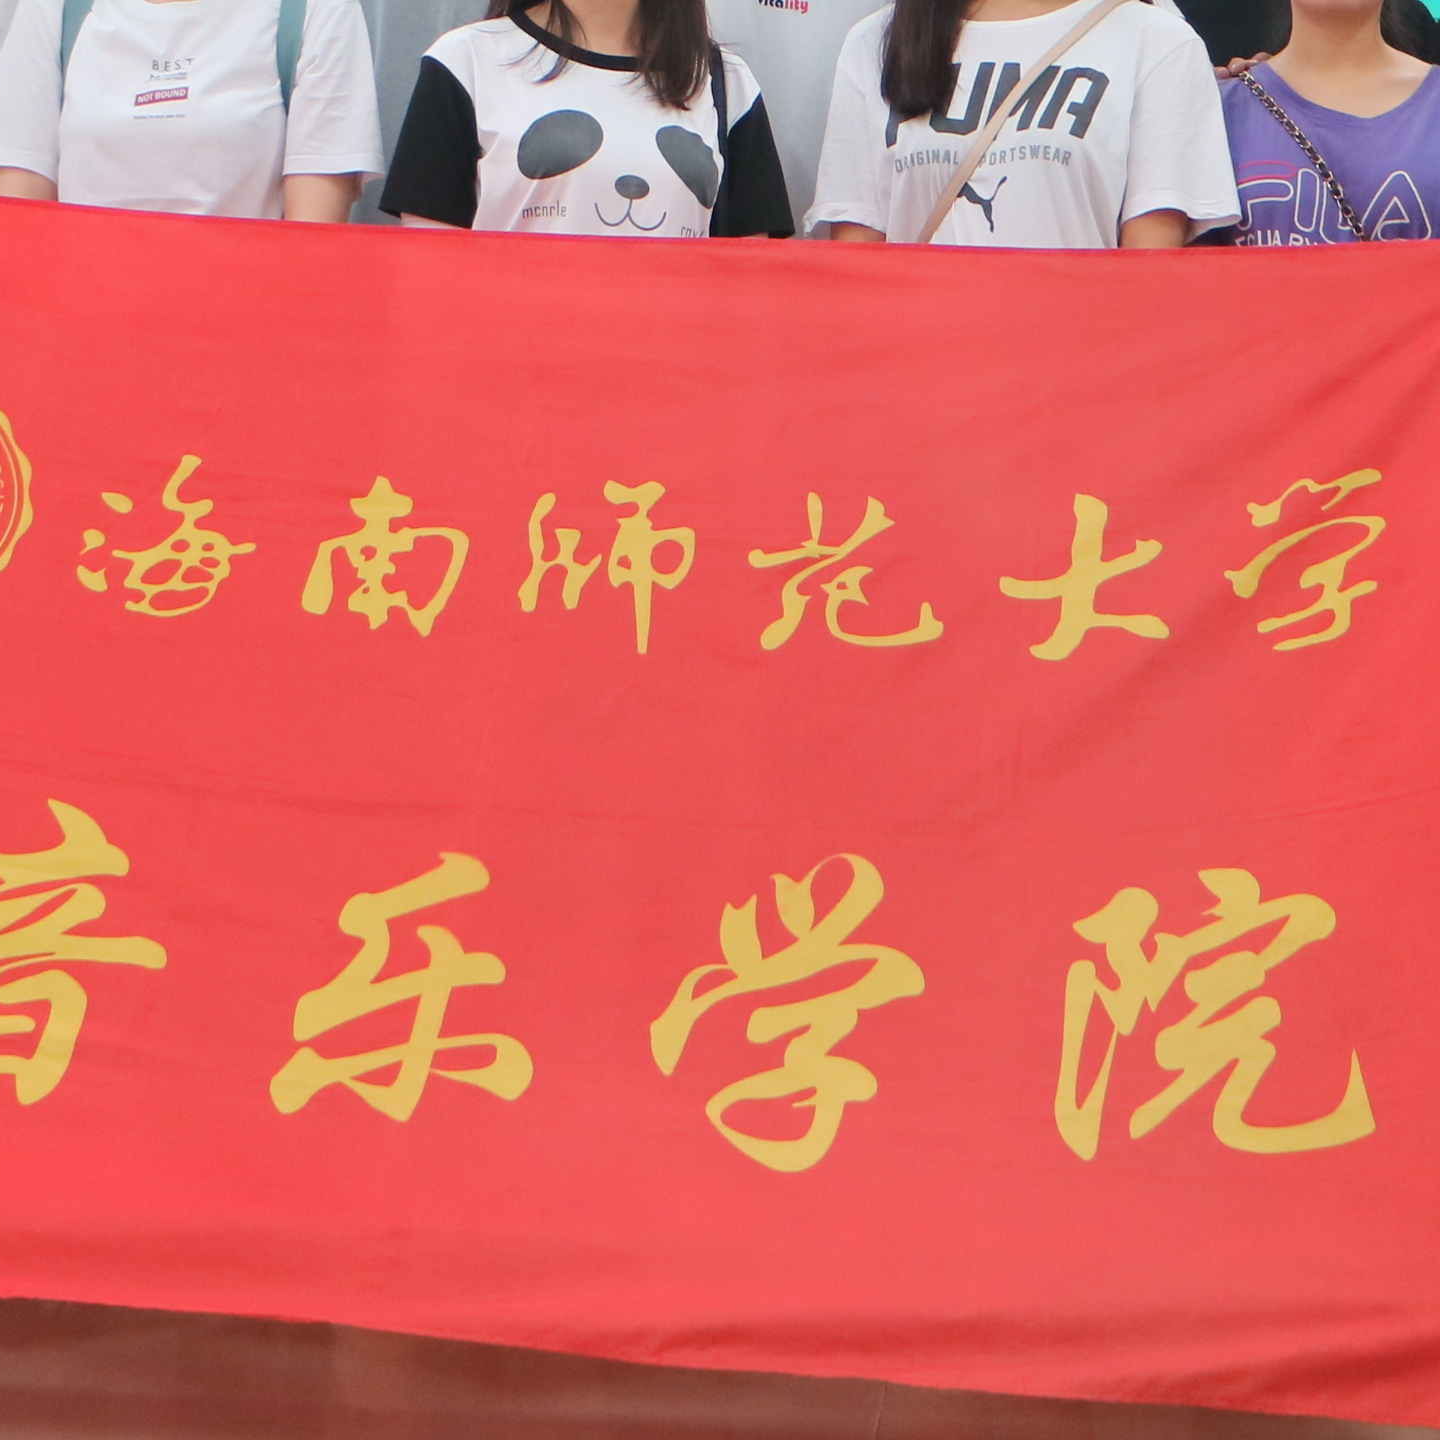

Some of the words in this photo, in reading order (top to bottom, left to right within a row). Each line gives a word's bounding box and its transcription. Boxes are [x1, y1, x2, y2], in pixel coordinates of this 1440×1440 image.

[152, 58, 194, 72] BEST
[137, 92, 154, 104] NOT
[154, 88, 187, 100] BOUND
[885, 61, 1110, 149] UMA
[895, 149, 960, 174] ORIGINAL
[978, 145, 1072, 168] PORTSWEAR
[77, 454, 1386, 660] 海南师范大学
